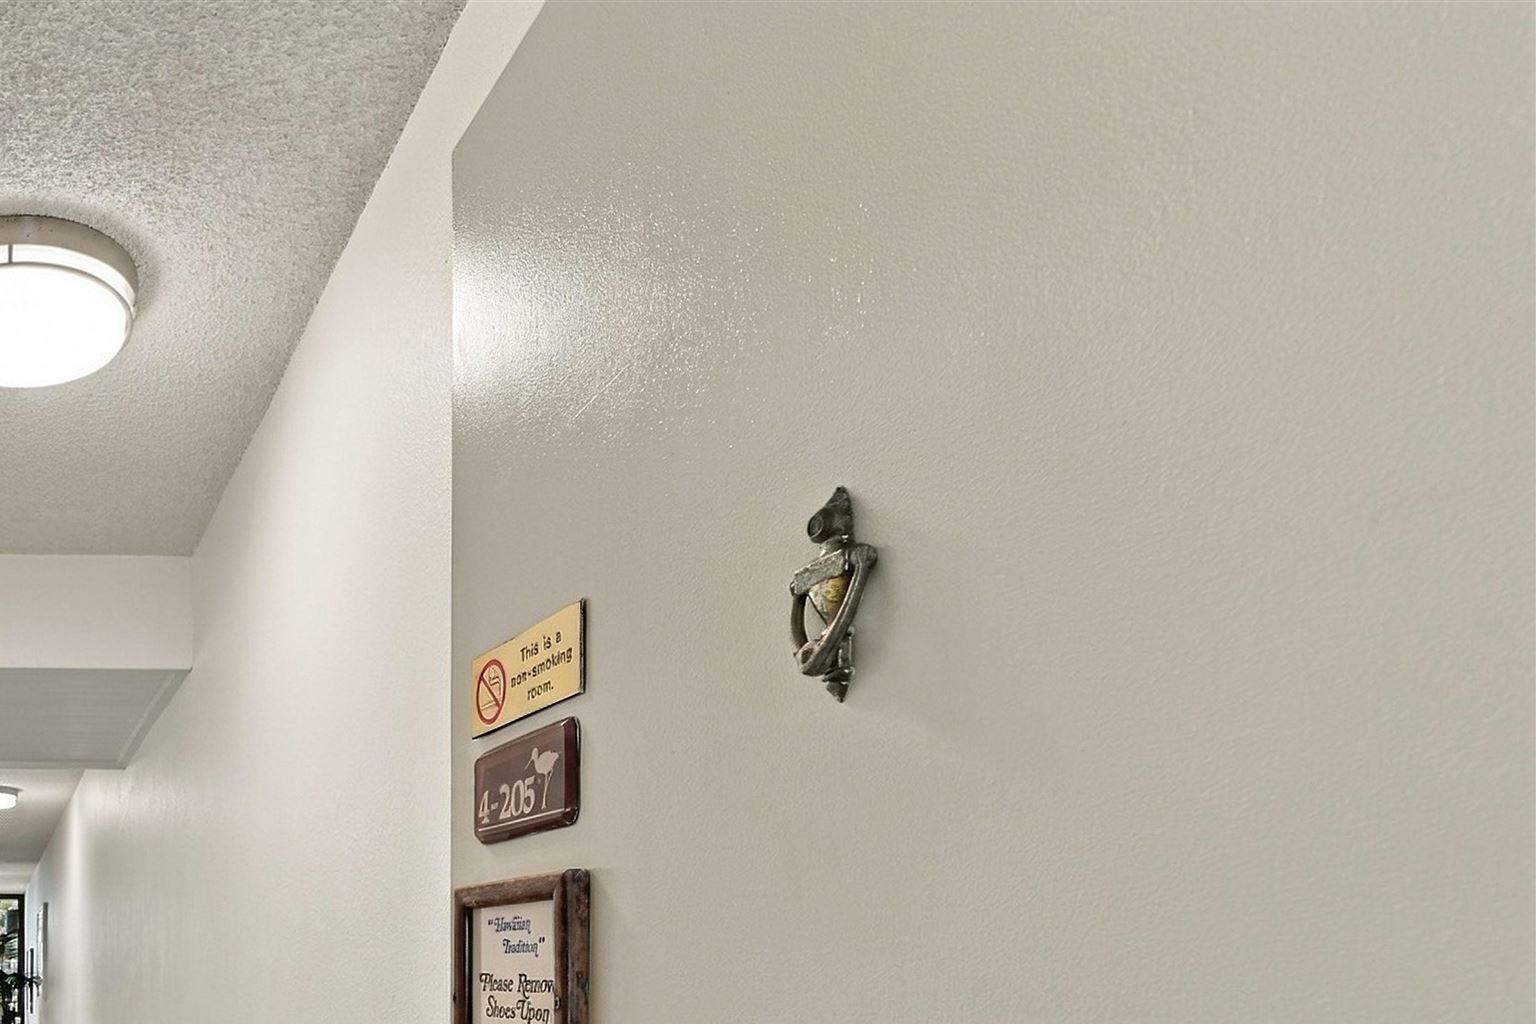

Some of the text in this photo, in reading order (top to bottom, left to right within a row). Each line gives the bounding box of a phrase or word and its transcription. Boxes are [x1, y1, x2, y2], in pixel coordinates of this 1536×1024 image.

[520, 631, 562, 662] This is a
[510, 647, 573, 688] non-smoking
[527, 681, 554, 701] room.
[478, 775, 536, 824] 4-205
[479, 973, 555, 999] Please Remov
[485, 995, 516, 1019] Shoes
